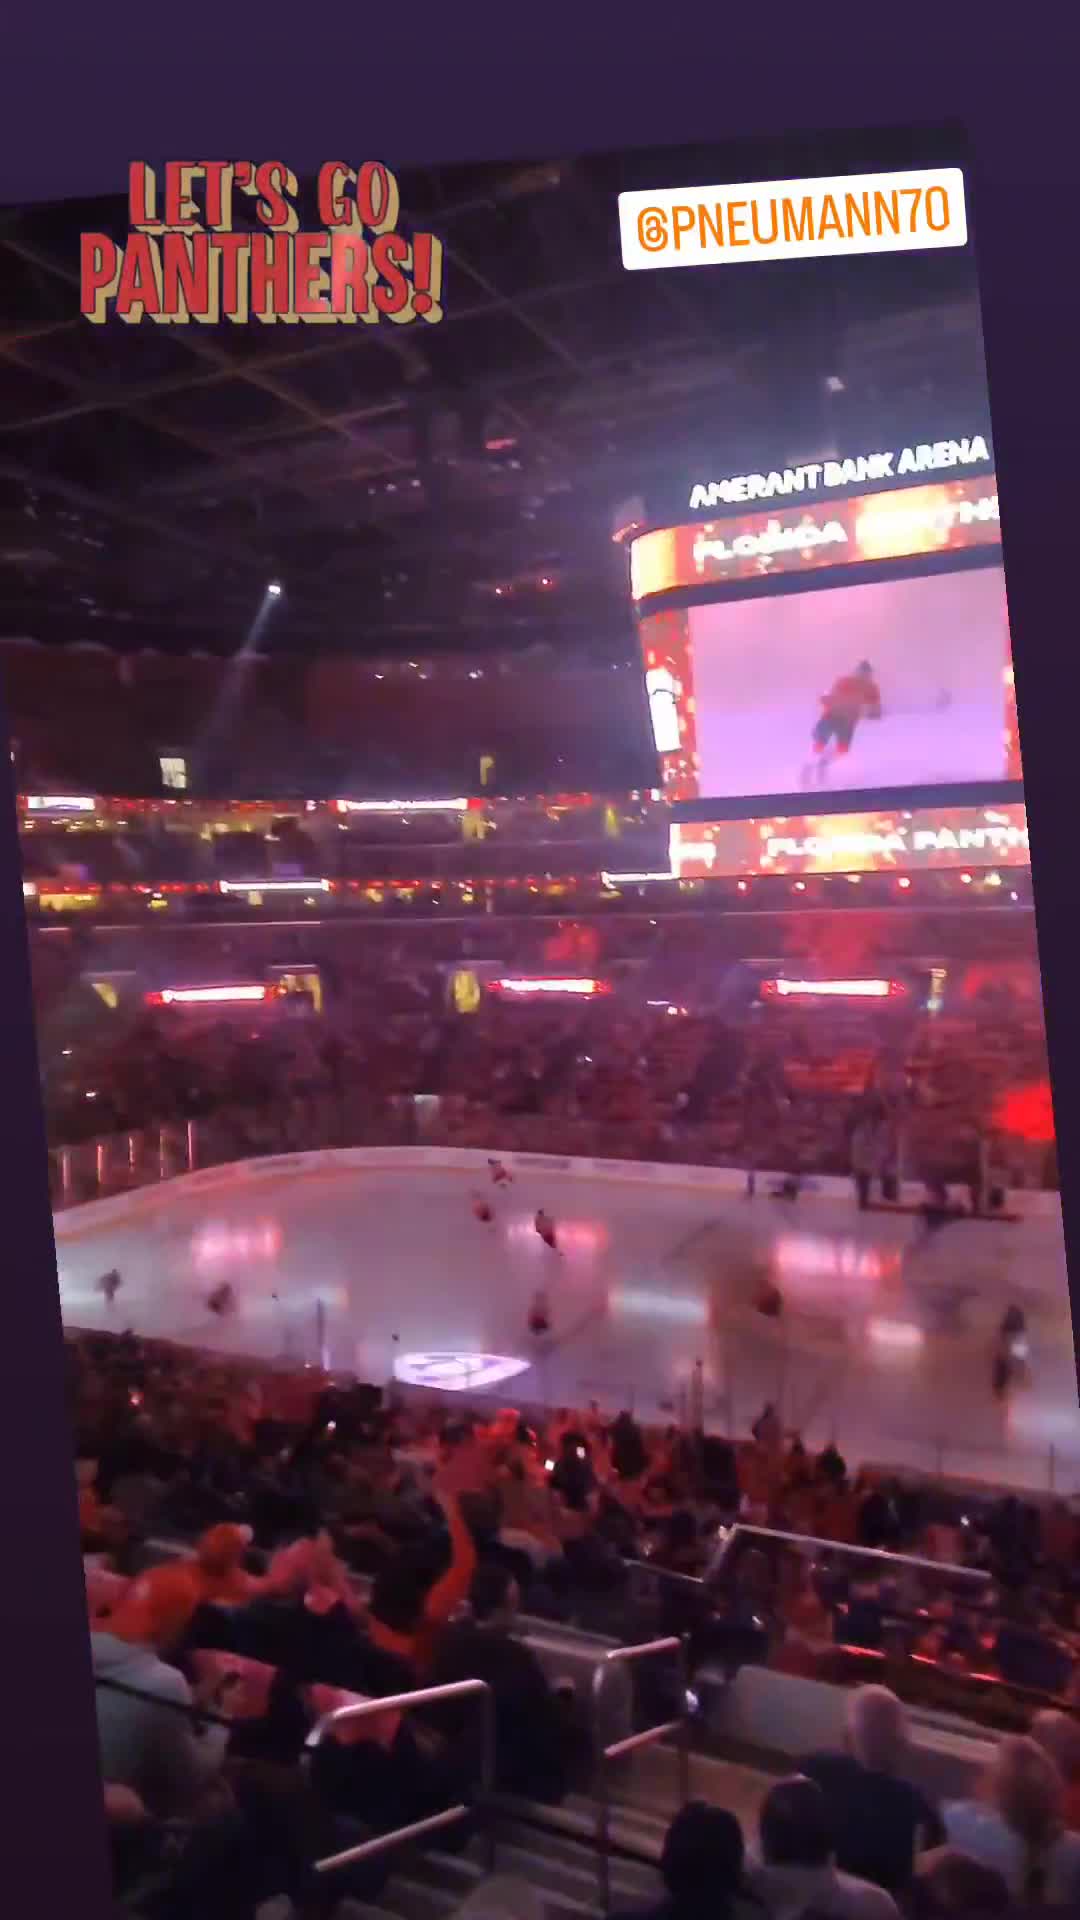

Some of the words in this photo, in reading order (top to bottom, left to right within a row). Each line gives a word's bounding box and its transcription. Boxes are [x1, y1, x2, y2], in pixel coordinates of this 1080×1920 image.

[689, 464, 823, 509] AMERANT
[823, 452, 894, 487] BANK
[897, 436, 989, 474] ARENA
[766, 835, 905, 858] FLODA
